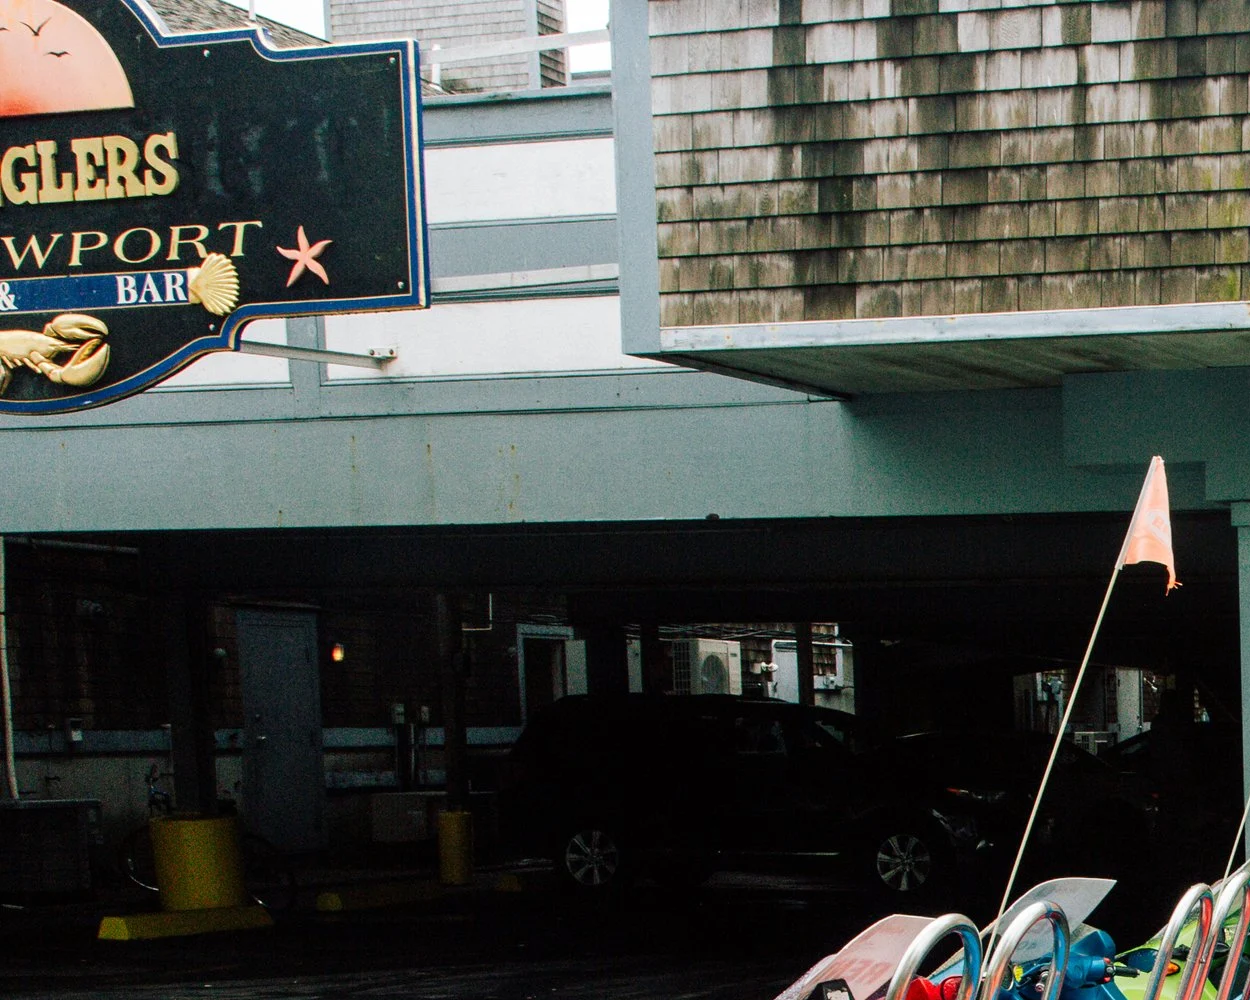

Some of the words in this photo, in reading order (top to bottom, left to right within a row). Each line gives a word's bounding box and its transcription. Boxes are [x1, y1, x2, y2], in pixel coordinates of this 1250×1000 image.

[1, 132, 180, 206] GLERS
[1, 220, 263, 271] WPORT
[116, 272, 188, 305] BAR
